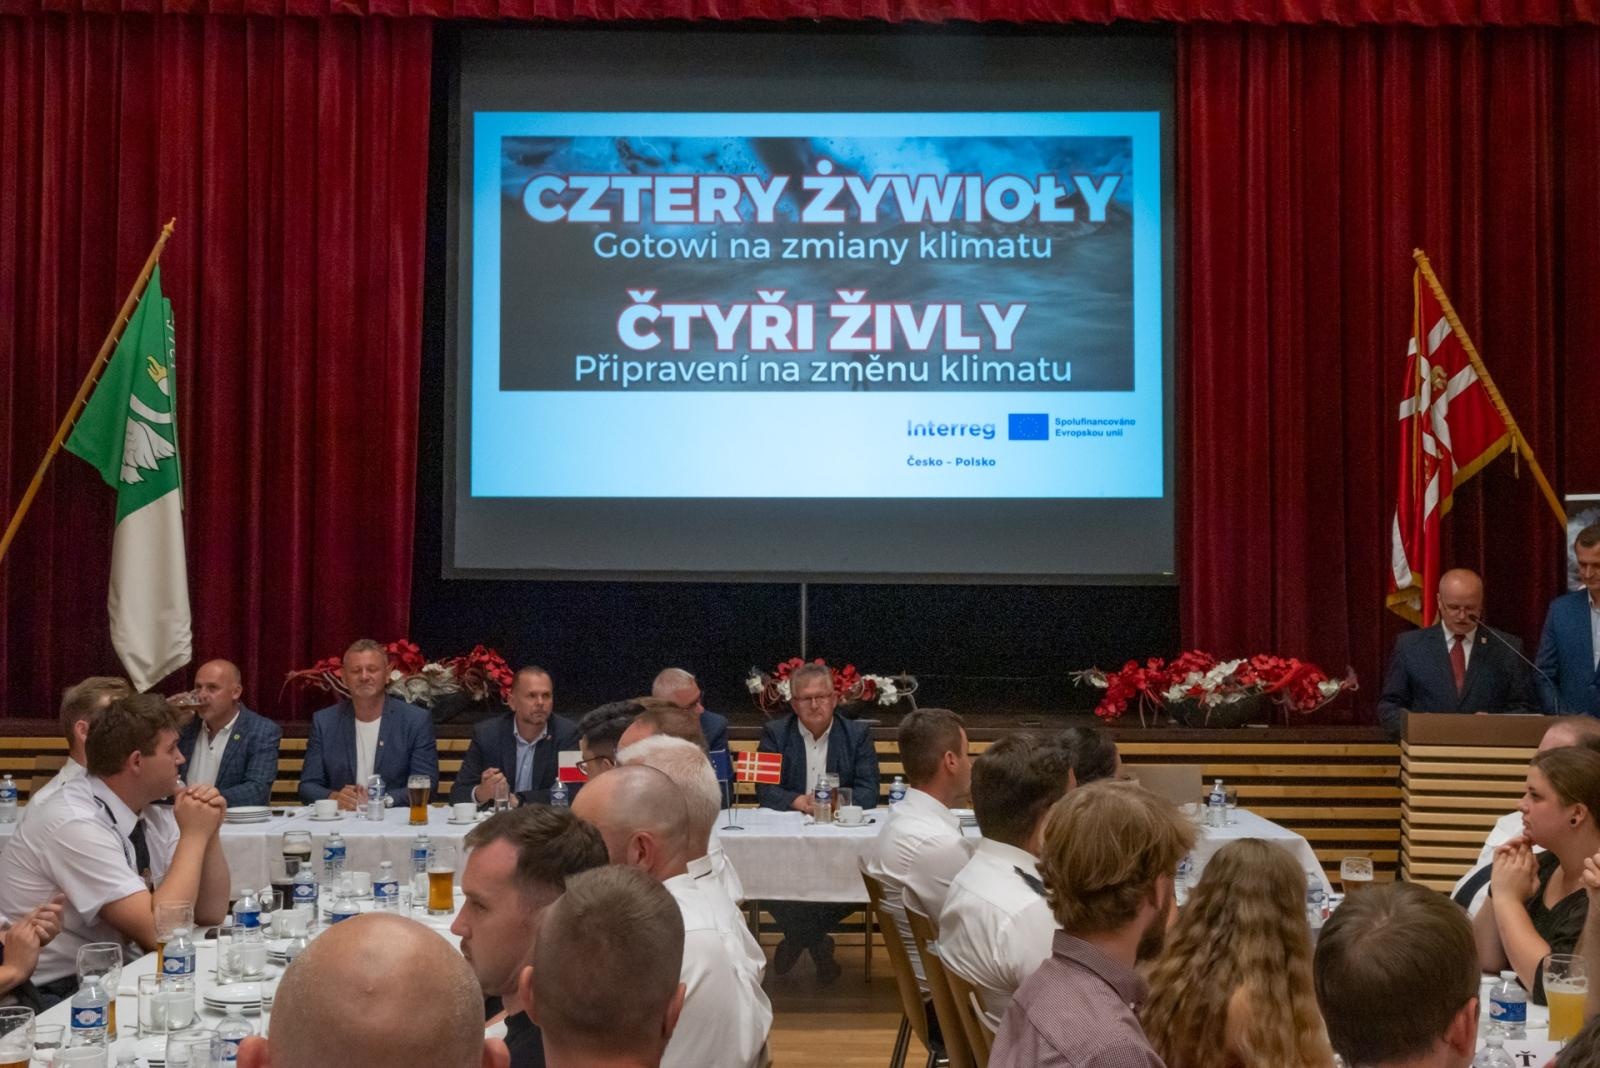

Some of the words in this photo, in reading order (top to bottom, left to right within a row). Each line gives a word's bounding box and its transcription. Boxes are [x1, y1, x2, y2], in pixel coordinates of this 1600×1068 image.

[522, 174, 790, 225] CZTERY
[801, 158, 1121, 225] ŻYWIOŁY
[593, 231, 719, 260] Gotowi
[729, 238, 772, 260] na
[781, 231, 909, 266] zmiany
[918, 231, 1053, 260] klimatu
[616, 289, 815, 352] ČTYŘI
[829, 289, 1027, 352] ŽIVLY
[574, 353, 749, 387] Připravení
[758, 362, 802, 383] na
[809, 354, 930, 383] změnu
[940, 355, 1073, 383] klimatu
[907, 420, 996, 440] Interreg
[1055, 417, 1136, 427] Spolufinancováno
[1055, 428, 1103, 438] Evropskou
[907, 455, 943, 467] Česko
[955, 457, 996, 467] Polsko
